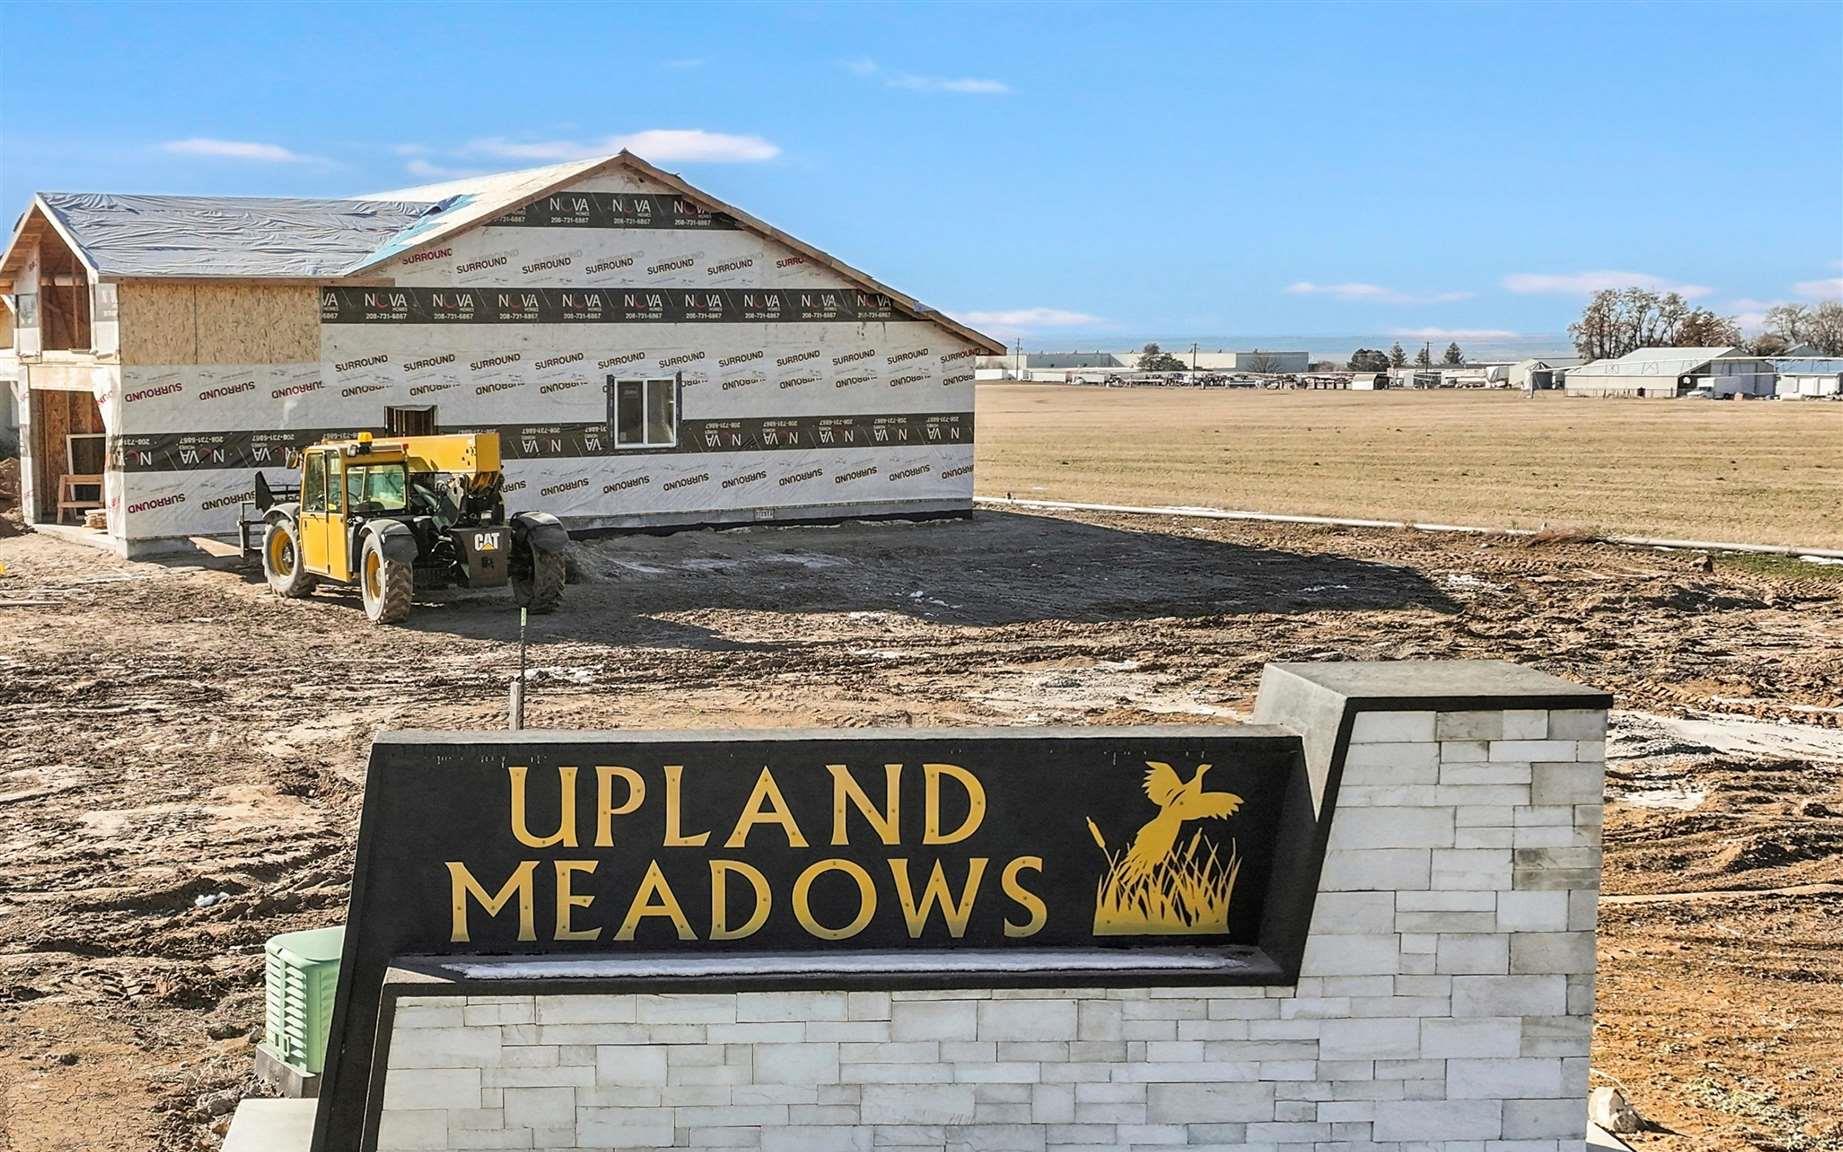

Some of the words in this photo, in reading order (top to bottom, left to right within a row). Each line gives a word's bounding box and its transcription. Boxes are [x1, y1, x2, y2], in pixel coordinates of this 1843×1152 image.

[456, 256, 508, 274] SURROUND
[521, 257, 572, 274] SURROUND
[585, 258, 634, 275] SURROUND
[647, 258, 694, 275] SURROUND
[707, 259, 754, 276] SURROUND
[322, 292, 338, 306] VA
[364, 293, 407, 308] NOVA
[432, 293, 474, 308] NOVA
[498, 293, 539, 308] NOVA
[562, 294, 601, 308] NOVA
[624, 294, 663, 308] NOVA
[685, 294, 722, 308] NOVA
[744, 294, 780, 308] NOVA
[801, 294, 837, 308] NOVA
[335, 354, 388, 373] SURROUND
[403, 353, 456, 372] SURROUND
[470, 353, 521, 371] SURROUND
[535, 352, 584, 370] SURROUND
[597, 352, 646, 369] SURROUND
[659, 351, 706, 369] SURROUND
[719, 350, 764, 368] SURROUND
[776, 350, 821, 367] SURROUND
[832, 349, 876, 366] SURROUND
[887, 348, 929, 365] SURROUND
[124, 382, 183, 403] SURROUND
[199, 381, 256, 401] SURROUND
[663, 472, 710, 491] SURROUND
[721, 470, 767, 489] SURROUND
[779, 468, 823, 486] SURROUND
[834, 466, 878, 484] SURROUND
[889, 464, 931, 481] SURROUND
[540, 477, 589, 497] SURROUND
[602, 475, 650, 494] SURROUND
[127, 493, 186, 514] SURROUND
[474, 532, 500, 551] CAT
[507, 762, 987, 849] UPLAND
[443, 856, 1048, 944] MEADOWS
